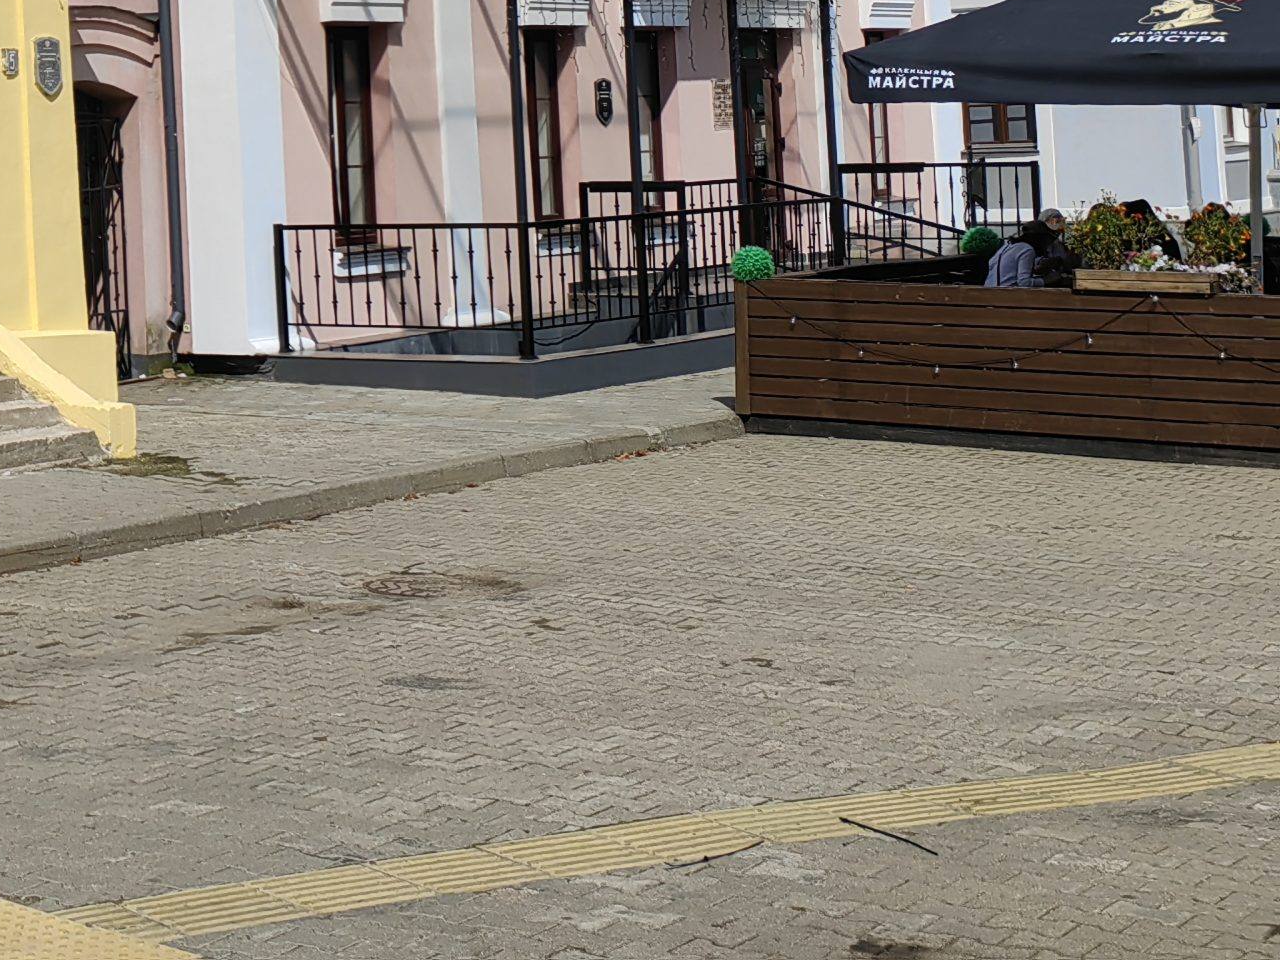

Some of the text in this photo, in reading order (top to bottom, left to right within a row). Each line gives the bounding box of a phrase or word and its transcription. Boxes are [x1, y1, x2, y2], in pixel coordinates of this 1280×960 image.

[1110, 34, 1226, 44] МАЙСТРА
[884, 67, 940, 76] КАЛЕКЦЫЯ
[868, 74, 956, 89] МАЙСТРА
